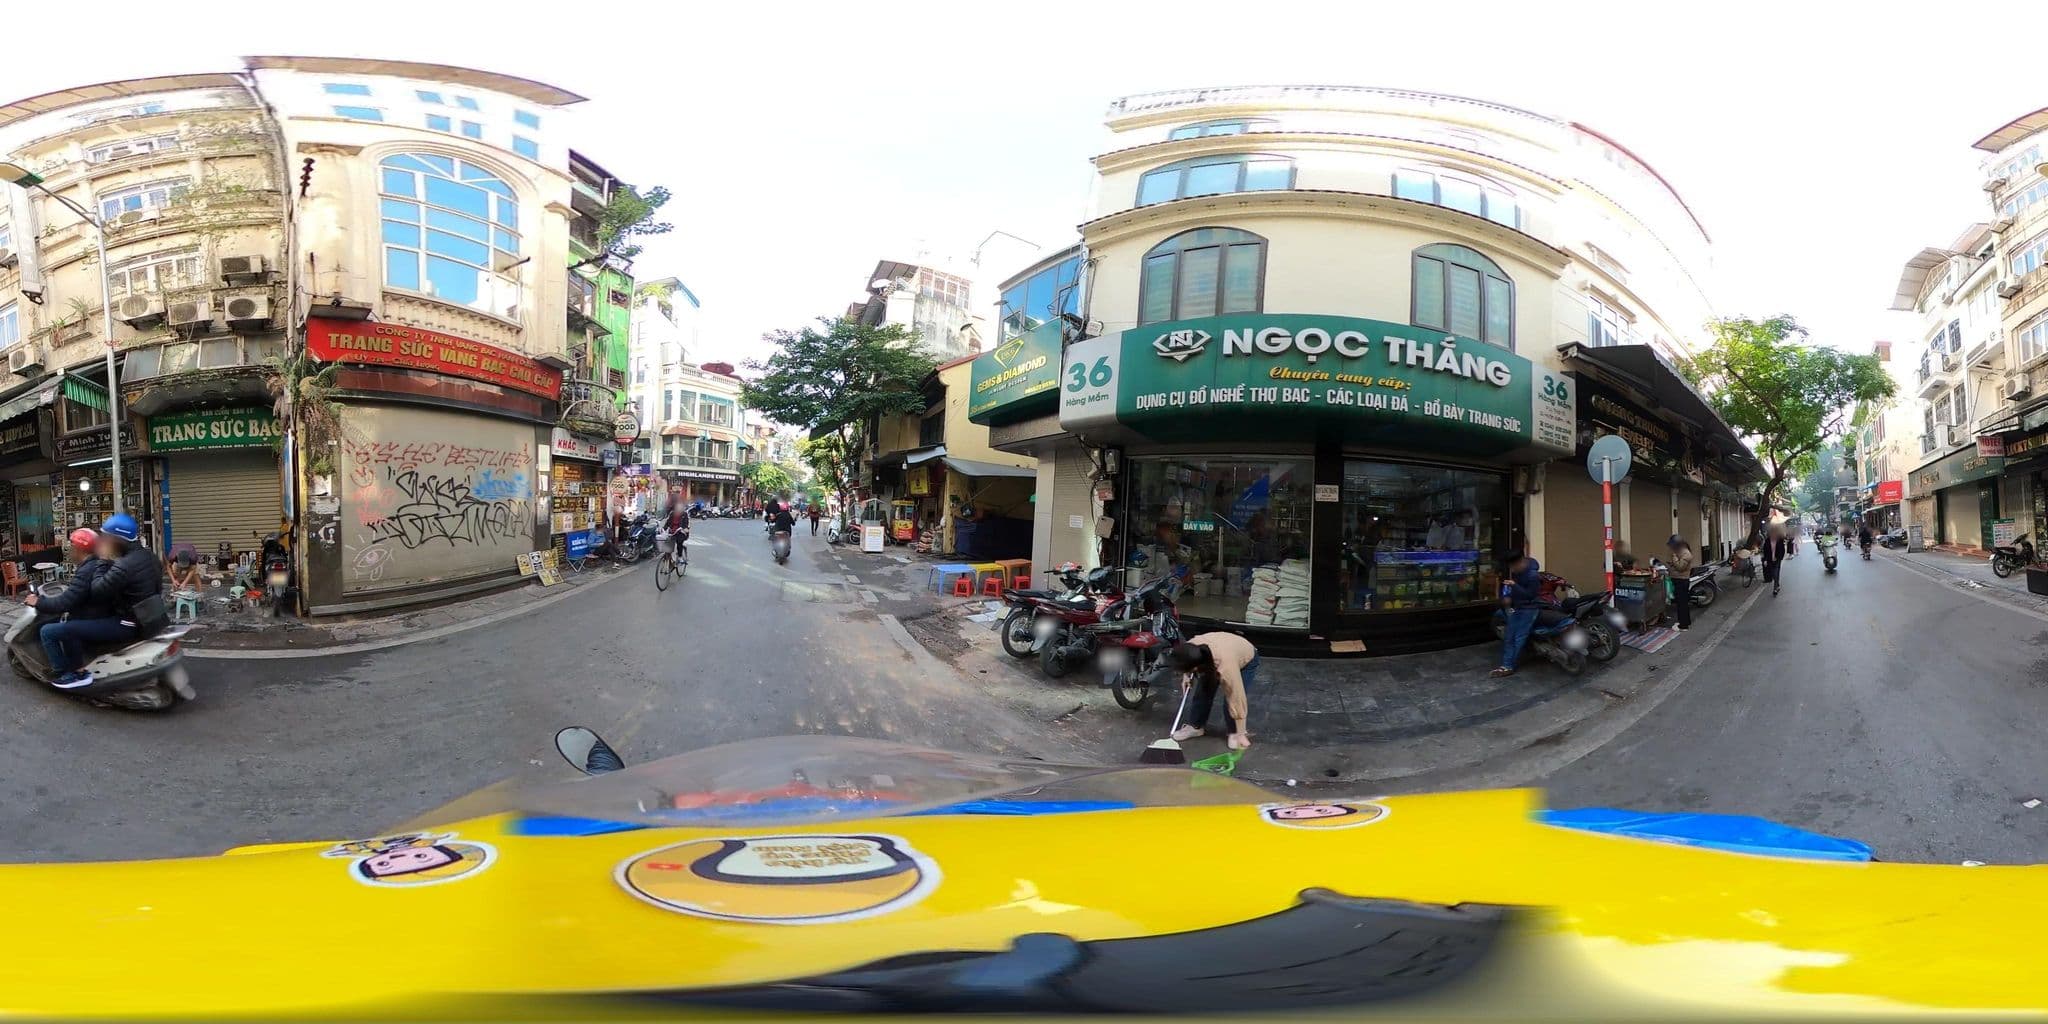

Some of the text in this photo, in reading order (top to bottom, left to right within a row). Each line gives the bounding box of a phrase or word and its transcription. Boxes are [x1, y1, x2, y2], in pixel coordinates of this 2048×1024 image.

[327, 332, 393, 353] TRANG
[1003, 355, 1047, 381] DIAMOND
[1222, 326, 1513, 387] NGỌC THẮNG
[1066, 355, 1113, 393] 36
[1269, 366, 1330, 383] Chuyên
[1335, 373, 1373, 387] cung
[1543, 375, 1568, 401] 36
[1065, 396, 1088, 407] Hàng
[1136, 393, 1168, 410] DỤNG
[1169, 391, 1185, 408] CỤ
[1189, 384, 1207, 405] ĐỒ
[1210, 383, 1247, 403] NGHỀ
[1250, 386, 1278, 404] THỢ
[1282, 387, 1310, 405] BẠC
[1326, 387, 1354, 405] CÁC
[1357, 391, 1387, 411] LOẠI
[1390, 391, 1409, 412] ĐÁ
[1443, 402, 1465, 421] BÀY
[1468, 409, 1502, 429] TRANG
[152, 422, 207, 444] TRANG
[210, 416, 245, 438] SỨC
[677, 471, 715, 480] HIGHLANDS
